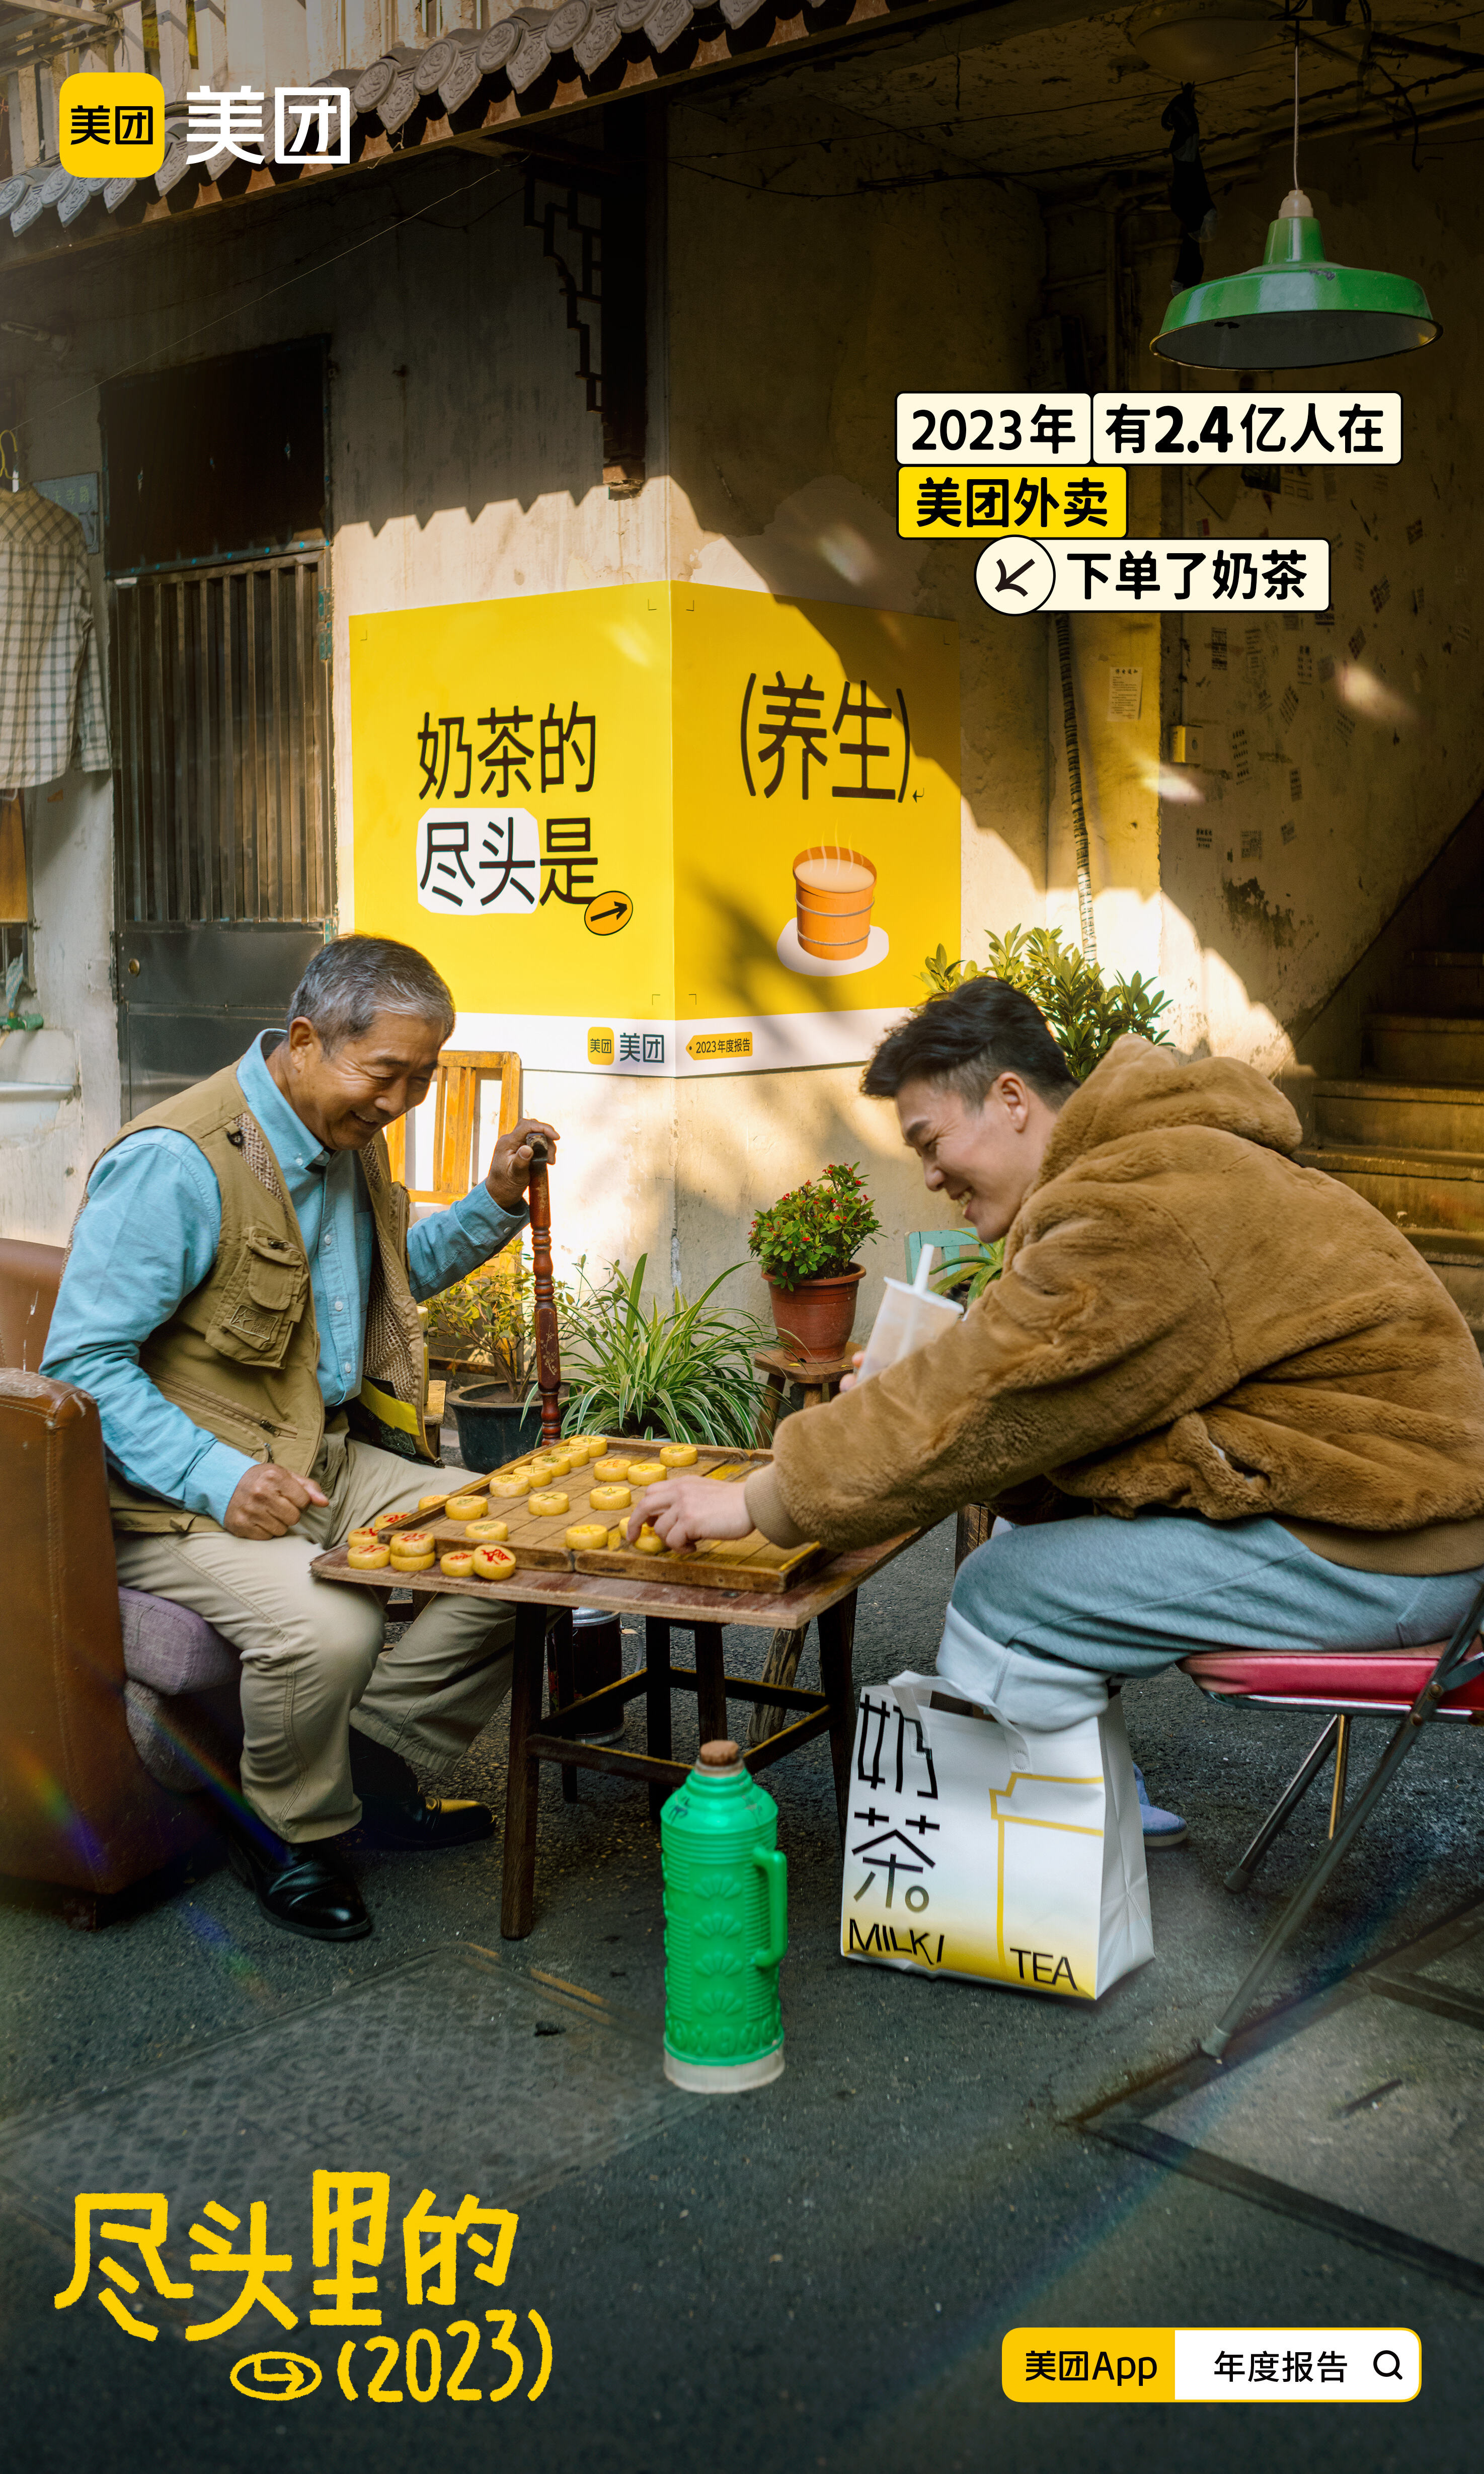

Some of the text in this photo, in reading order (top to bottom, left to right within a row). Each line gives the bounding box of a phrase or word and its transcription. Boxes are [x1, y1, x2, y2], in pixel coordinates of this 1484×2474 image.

[418, 701, 596, 800] 奶茶的
[420, 816, 598, 907] 尽头是
[590, 1038, 612, 1054] 美团
[619, 1032, 665, 1064] 美团
[695, 1037, 750, 1055] 2023年度报告
[1009, 1947, 1078, 1991] TEA
